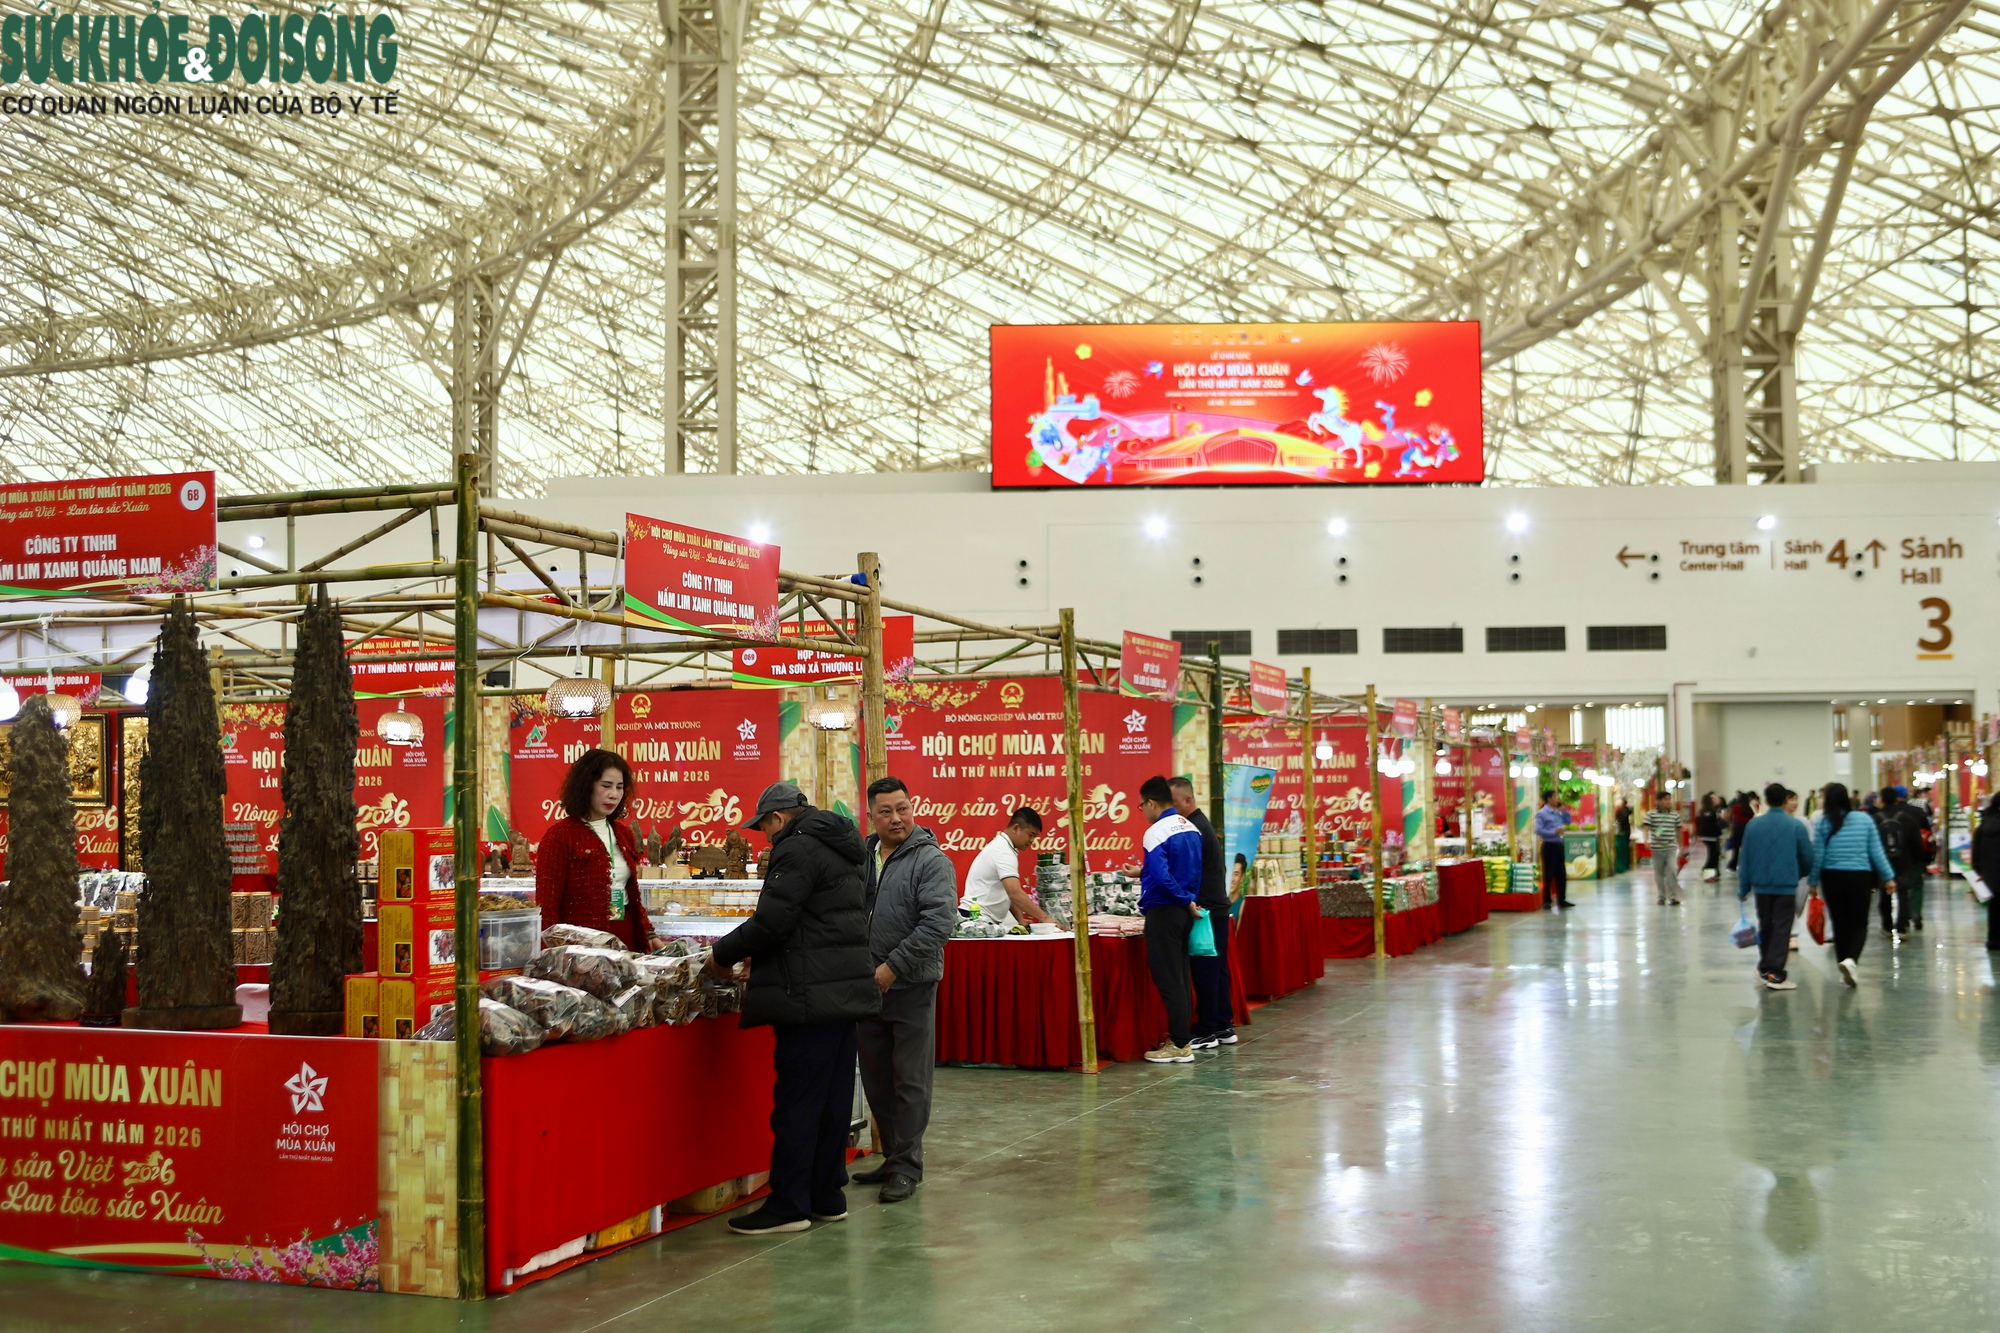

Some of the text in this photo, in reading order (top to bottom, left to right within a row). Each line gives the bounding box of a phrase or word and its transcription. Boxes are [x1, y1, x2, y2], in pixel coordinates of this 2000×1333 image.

[1173, 360, 1290, 379] HỘI CHỢ MÙA XUÂN
[1262, 377, 1285, 389] 2026
[9, 489, 29, 504] MÙA
[31, 488, 56, 503] XUÂN
[58, 486, 75, 501] LẦN
[78, 485, 96, 499] THỨ
[98, 482, 122, 498] NHẤT
[124, 483, 146, 497] NĂM
[149, 483, 172, 495] 2026
[187, 489, 200, 502] 68
[35, 506, 56, 521] Việt
[67, 504, 87, 517] Lan
[122, 501, 150, 513] Xuân
[25, 534, 117, 556] CÔNG TY TNHH
[1680, 540, 1760, 557] Trung tâm
[1784, 540, 1823, 554] Sảnh
[1826, 538, 1849, 570] 4
[1900, 537, 1963, 560] Sảnh
[17, 562, 40, 580] LIM
[43, 561, 78, 579] XANH
[83, 554, 127, 577] QUẢNG
[130, 557, 162, 575] NAM
[1680, 560, 1744, 572] Center Hall
[1784, 560, 1807, 571] Hall
[682, 569, 733, 596] CÔNG TY TNHH
[1901, 566, 1942, 585] Hall
[657, 586, 755, 620] NẤM LIM XANH QUẢNG NAM
[1917, 596, 1953, 652] 3
[358, 661, 456, 674] TY TNHH ĐÔNG Y QUANG ANH
[771, 663, 787, 675] TRÀ
[788, 663, 806, 675] SƠN
[808, 662, 819, 674] XÃ
[821, 662, 854, 676] THƯỢNG
[616, 720, 701, 731] NGHIỆP VÀ MÔI TRƯỜNG
[945, 711, 1045, 723] BỘ NÔNG NGHIỆP VÀ MÔI
[583, 724, 594, 732] BỘ
[633, 738, 671, 763] MÙA
[675, 736, 721, 762] XUÂN
[922, 730, 1046, 761] HỘI CHỢ MÙA
[252, 746, 276, 773] HỘI
[655, 769, 710, 783] NĂM 2026
[932, 762, 1056, 778] LẦN THỨ NHẤT NĂM
[260, 774, 278, 788] LẦN
[358, 776, 382, 786] 2026
[232, 802, 279, 829] Nông
[632, 788, 743, 830] Việt 2026
[961, 797, 998, 816] sản
[939, 828, 1067, 851] Lan sắc
[0, 1055, 223, 1107] CHỢ MÙA XUÂN
[2, 1113, 201, 1148] THỨ NHẤT NĂM 2026
[282, 1121, 330, 1137] HỘI CHỢ
[276, 1136, 336, 1152] MÙA XUÂN
[12, 1151, 56, 1179] sản
[58, 1149, 116, 1188] Việt
[122, 1151, 176, 1186] 2026
[1, 1181, 225, 1225] Lan tỏa sắc Xuân
